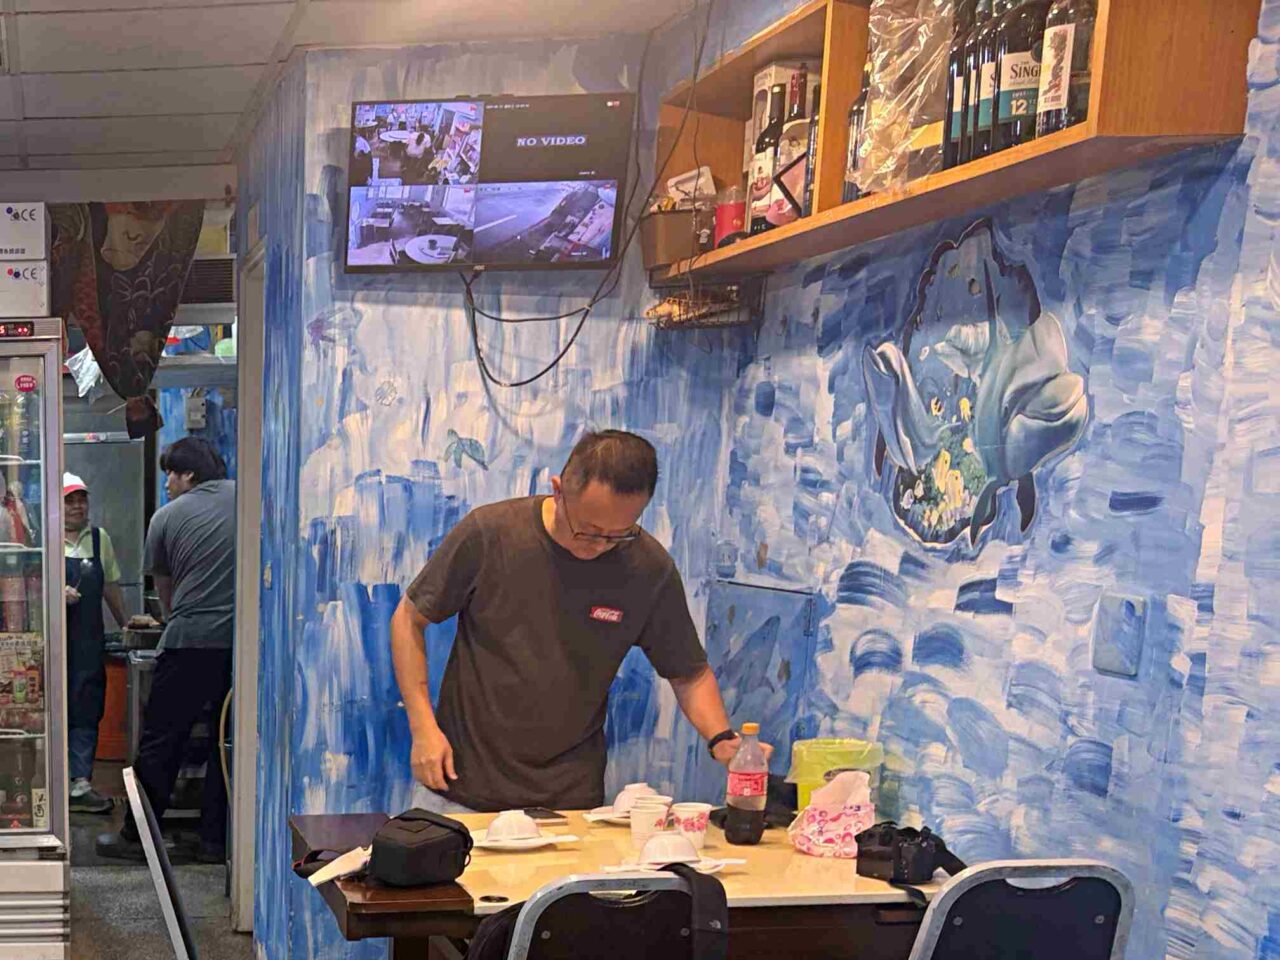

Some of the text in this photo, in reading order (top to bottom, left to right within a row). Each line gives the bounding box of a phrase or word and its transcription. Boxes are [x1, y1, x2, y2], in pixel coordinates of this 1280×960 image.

[1011, 99, 1028, 115] 12
[517, 135, 586, 147] NO VIDEO
